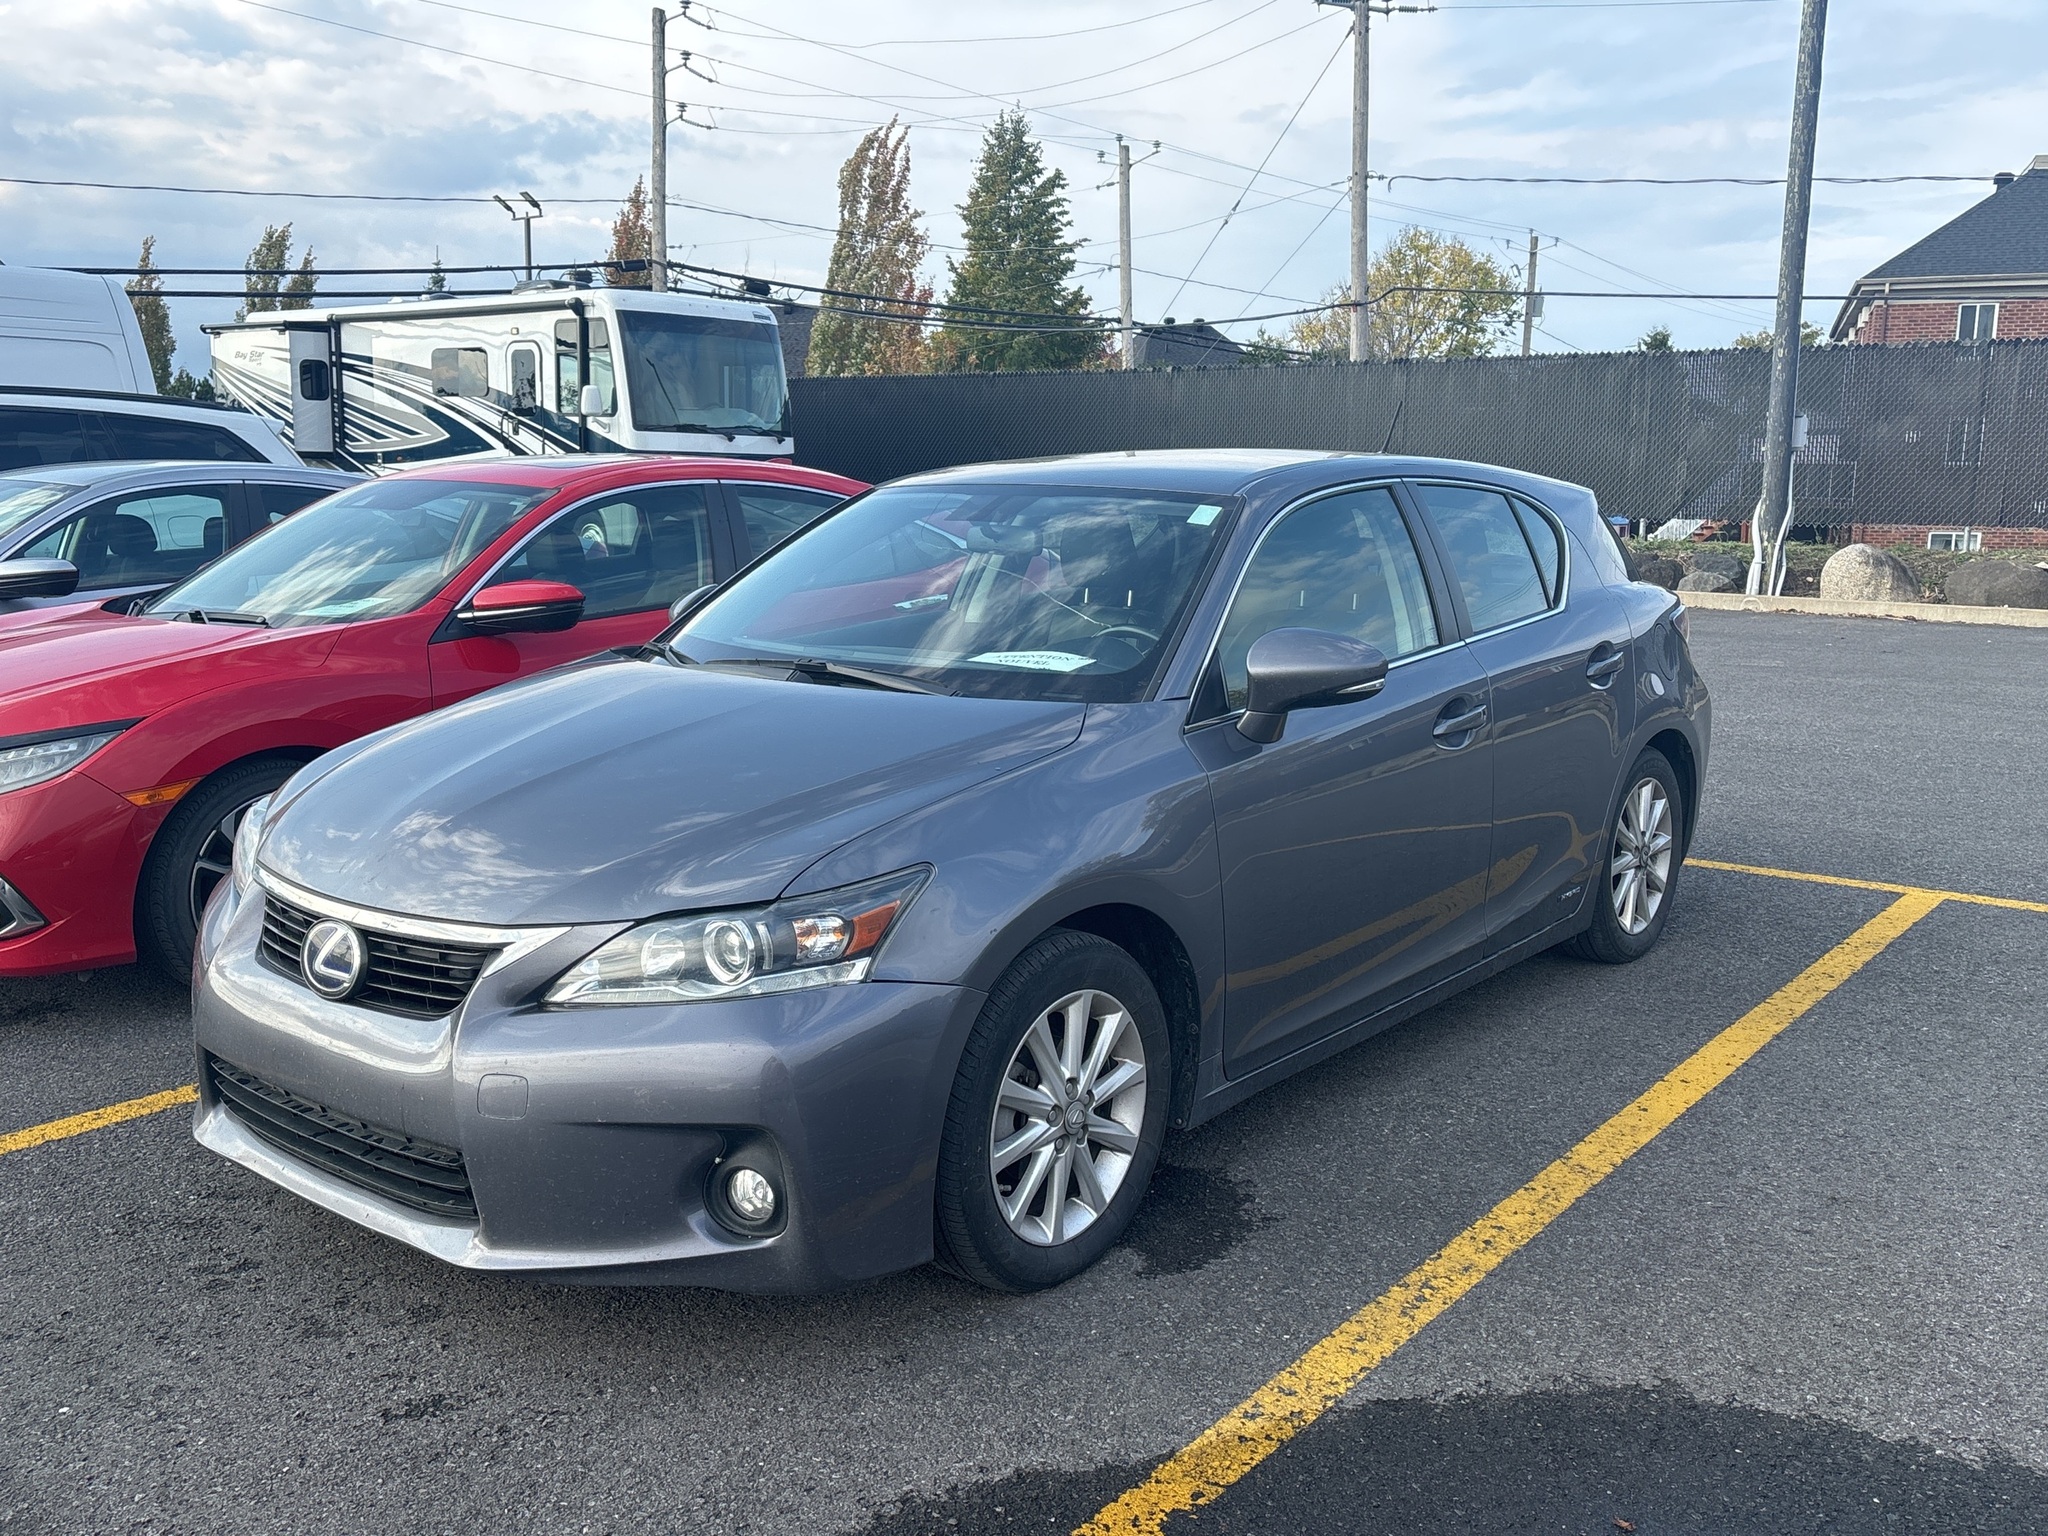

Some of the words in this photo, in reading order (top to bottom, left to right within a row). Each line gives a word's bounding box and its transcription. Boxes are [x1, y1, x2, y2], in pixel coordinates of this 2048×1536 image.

[234, 351, 248, 360] Bay
[249, 350, 265, 358] Star
[992, 654, 1074, 662] ATTENTION
